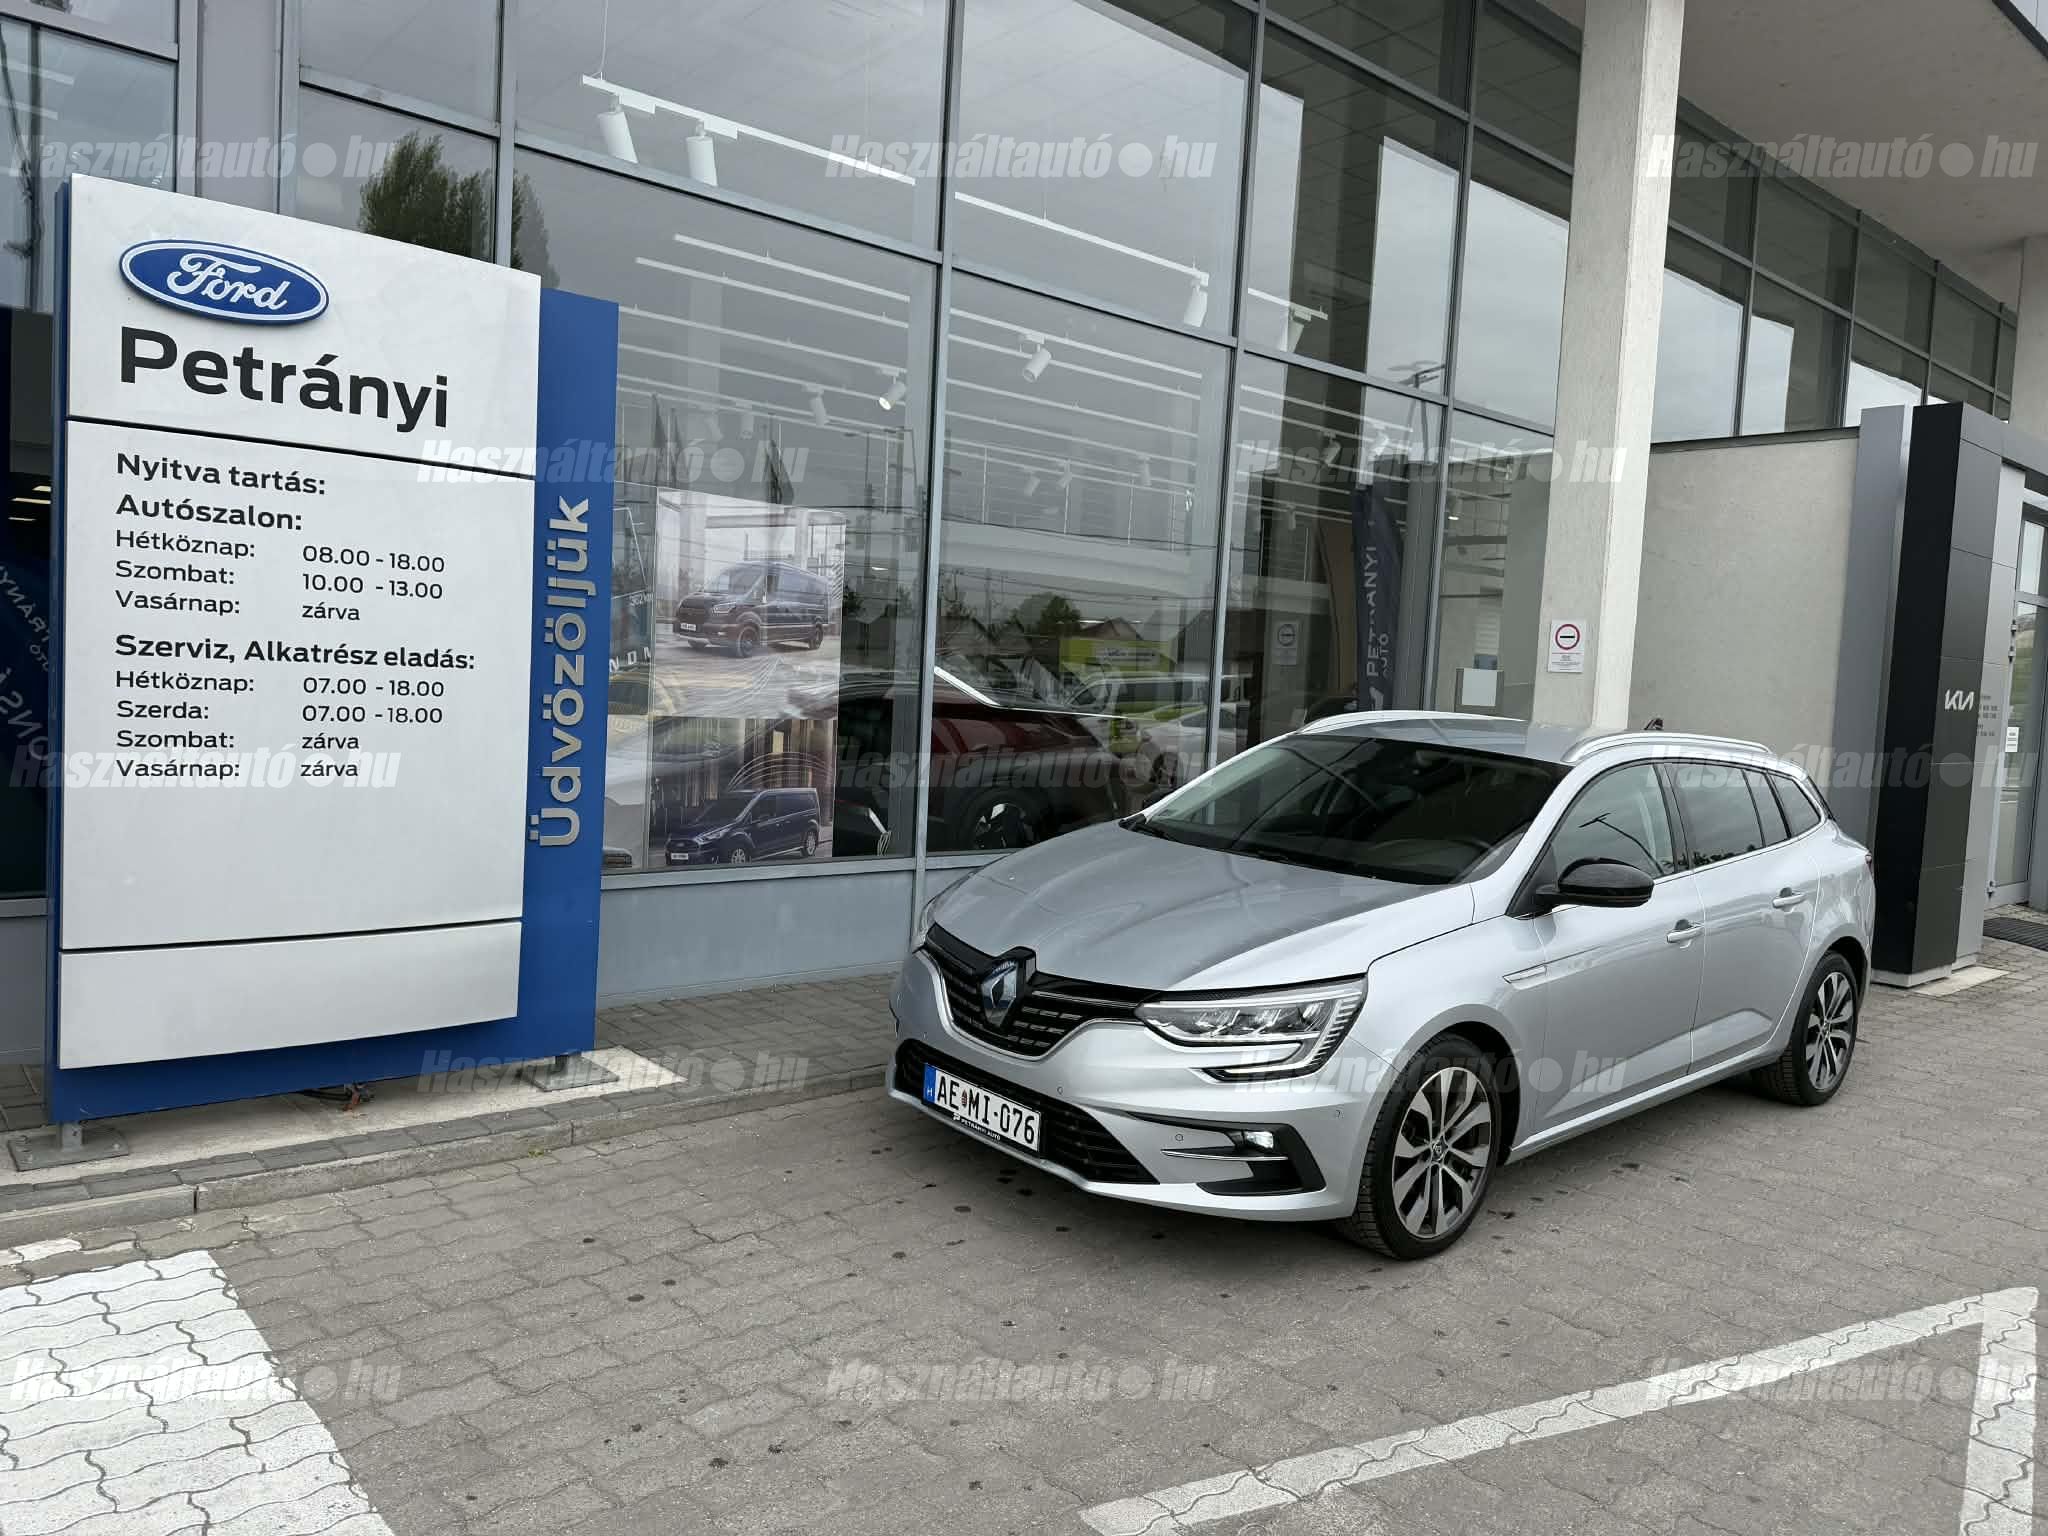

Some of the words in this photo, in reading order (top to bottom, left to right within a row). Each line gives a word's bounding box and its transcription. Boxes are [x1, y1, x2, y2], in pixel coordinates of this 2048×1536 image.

[166, 252, 291, 310] Ford
[121, 326, 448, 433] Petrányi
[117, 452, 221, 485] Nyitva
[228, 466, 325, 495] tartás:
[116, 494, 303, 531] Autószalon:
[116, 529, 255, 558] Hétköznap:
[302, 545, 370, 567] 08.00
[389, 552, 445, 573] 18.00
[116, 560, 235, 585] Szombat:
[302, 573, 364, 594] 10.00
[388, 580, 443, 600] 13.00
[115, 589, 240, 616] Vasárnap:
[301, 601, 361, 621] zárva
[115, 634, 235, 664] Szerviz,
[243, 640, 378, 666] Alkatrész
[383, 646, 476, 670] eladás:
[116, 670, 254, 695] Hétköznap:
[529, 495, 597, 846] Üdvözöljük
[303, 677, 367, 695] 07.00
[389, 679, 445, 697] 18.00
[116, 700, 209, 720] Szerda:
[302, 704, 366, 723] 07.00
[387, 707, 443, 724] 18.00
[116, 729, 234, 748] Szombat:
[301, 732, 360, 750] zárva
[116, 759, 240, 780] Vasárnap:
[300, 760, 358, 777] zárva
